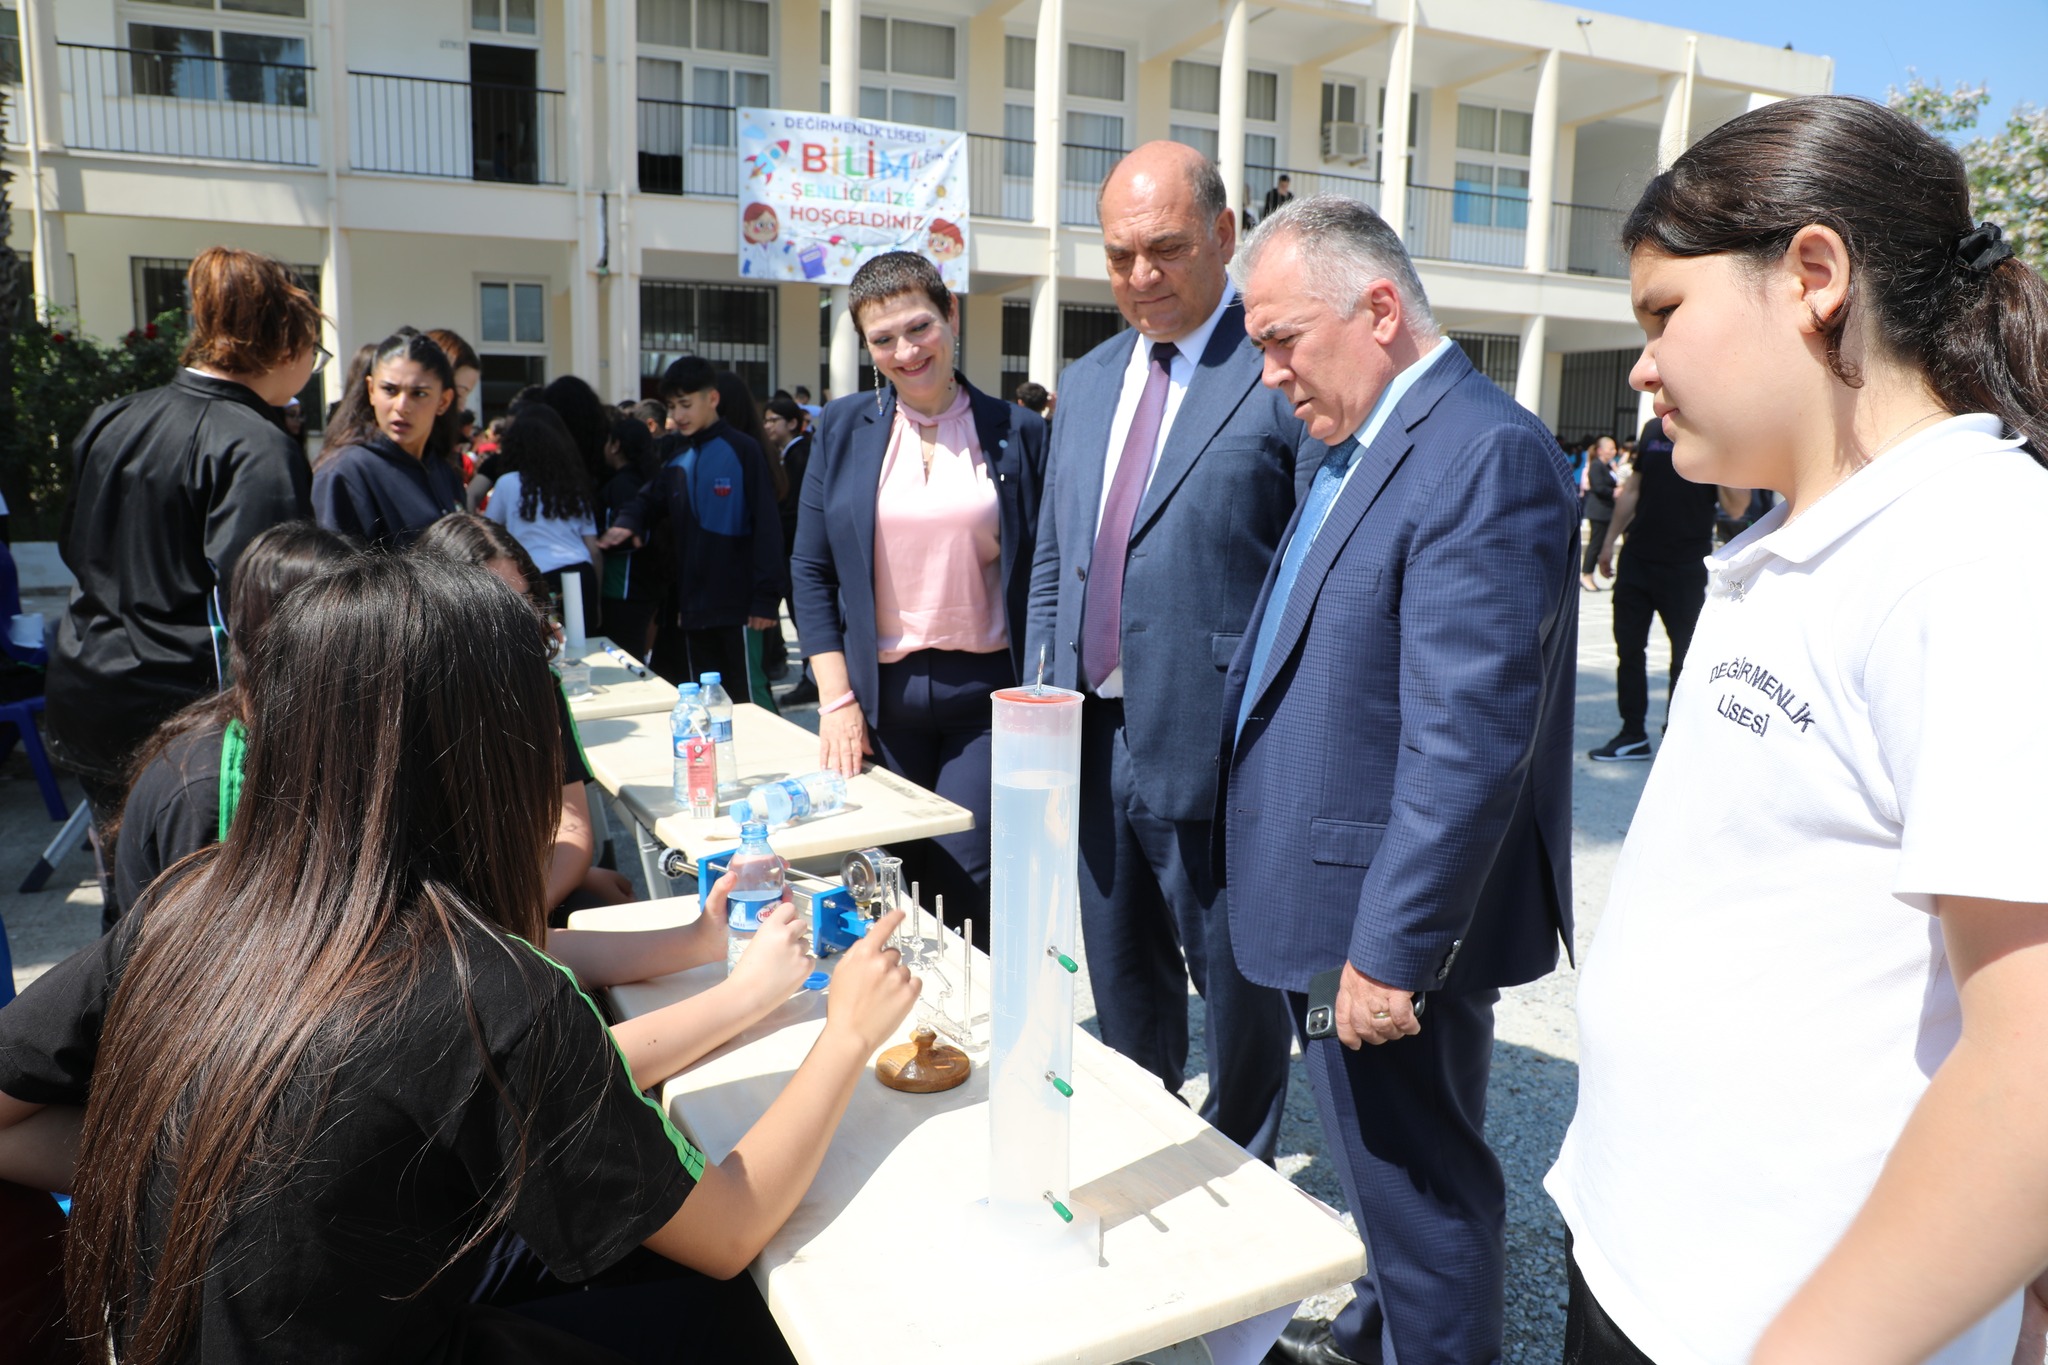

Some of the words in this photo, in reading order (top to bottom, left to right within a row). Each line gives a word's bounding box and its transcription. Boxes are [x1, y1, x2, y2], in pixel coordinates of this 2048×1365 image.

[784, 115, 882, 137] DEĞİRMENLİK
[886, 126, 926, 143] LİSESİ
[801, 138, 909, 182] BİLİM
[791, 182, 915, 207] ŞENLİĞİMİZE
[790, 205, 924, 231] HOŞGELDİNİZ
[1709, 656, 1815, 733] DEĞİRMENLİK
[1717, 694, 1770, 737] LİSESİ
